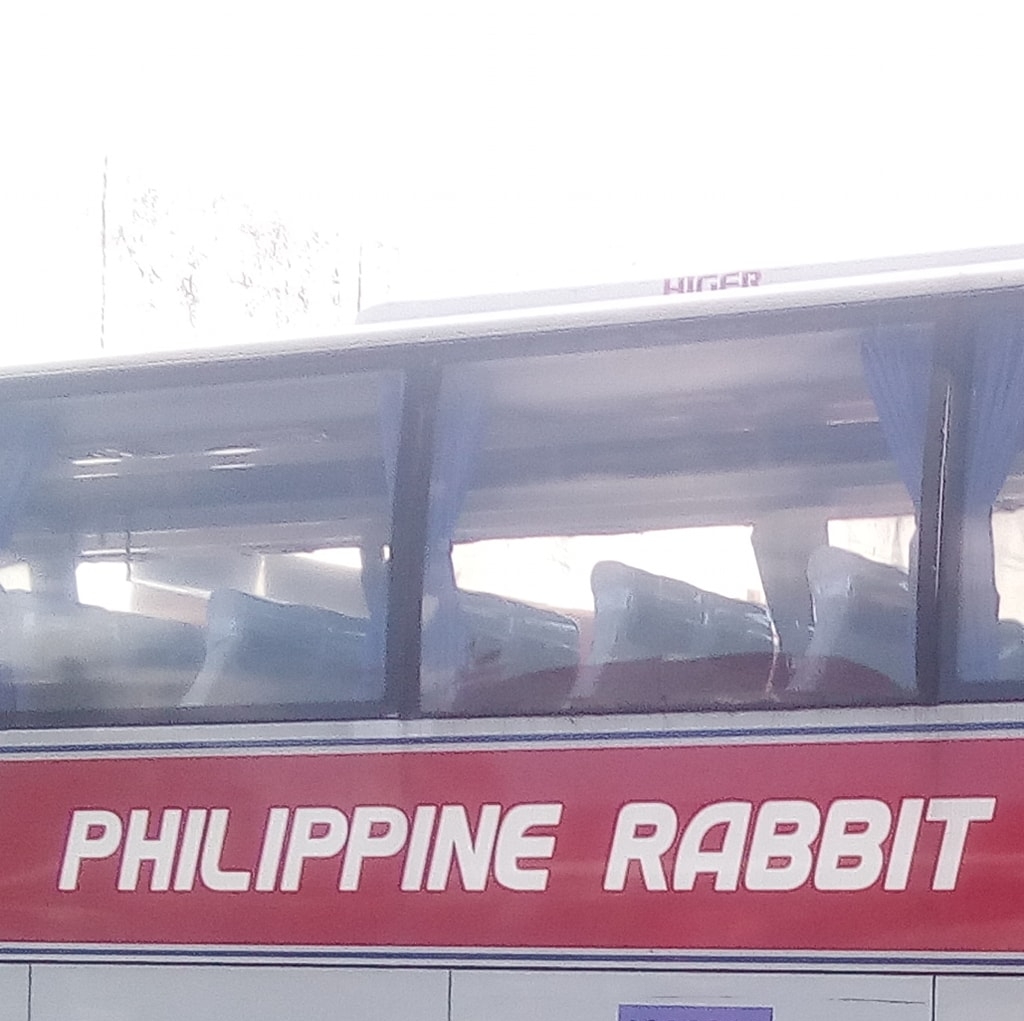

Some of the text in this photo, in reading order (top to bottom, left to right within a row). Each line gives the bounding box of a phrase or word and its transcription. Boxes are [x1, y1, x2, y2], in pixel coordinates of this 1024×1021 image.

[663, 270, 762, 295] HIGER
[59, 796, 997, 892] PHILIPPINE RABBIT
